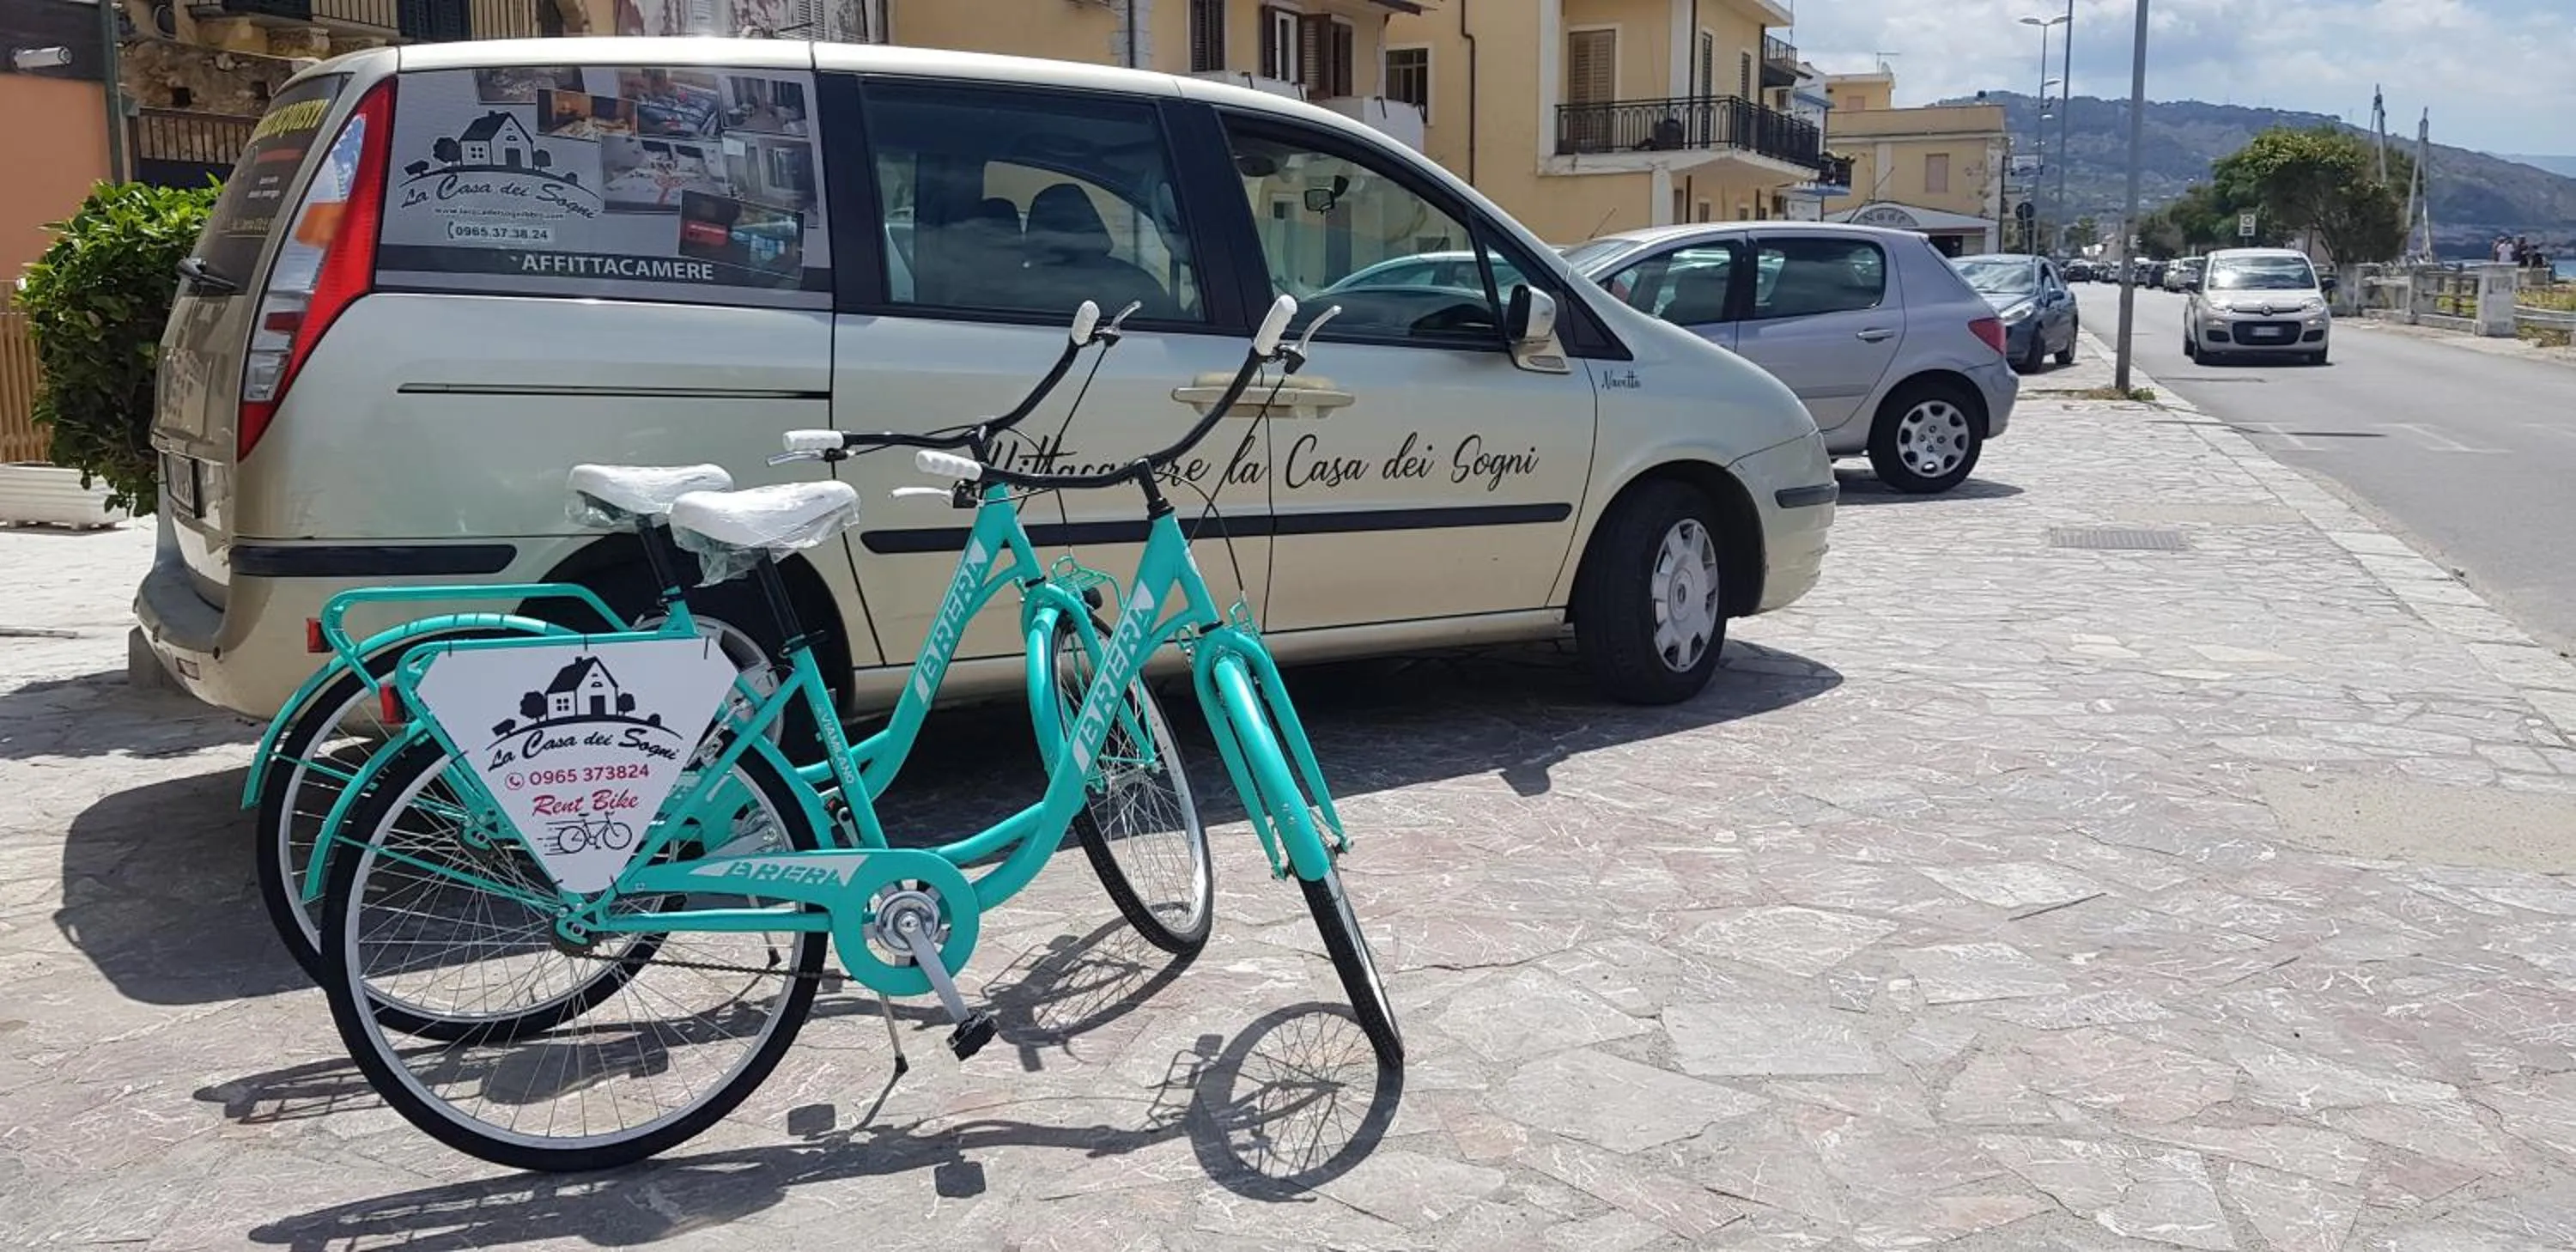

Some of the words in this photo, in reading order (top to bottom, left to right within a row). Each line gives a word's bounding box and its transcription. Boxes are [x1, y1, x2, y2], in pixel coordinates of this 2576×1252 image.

[401, 188, 429, 209] La
[435, 173, 494, 201] Casa
[500, 180, 531, 198] dei
[535, 183, 597, 220] Sogni
[521, 253, 715, 281] AFFITTACAMERE
[1228, 434, 1268, 484] la
[1285, 433, 1371, 489] Casa
[1382, 431, 1435, 481] dei
[1450, 433, 1540, 493] Sogni
[487, 748, 516, 772] La
[521, 729, 579, 759] Casa
[584, 732, 614, 747] dei
[617, 727, 681, 760] Sogni
[529, 768, 579, 786] 0965
[583, 763, 651, 783] 373824
[531, 794, 586, 817] Rent
[591, 788, 640, 811] Bike
